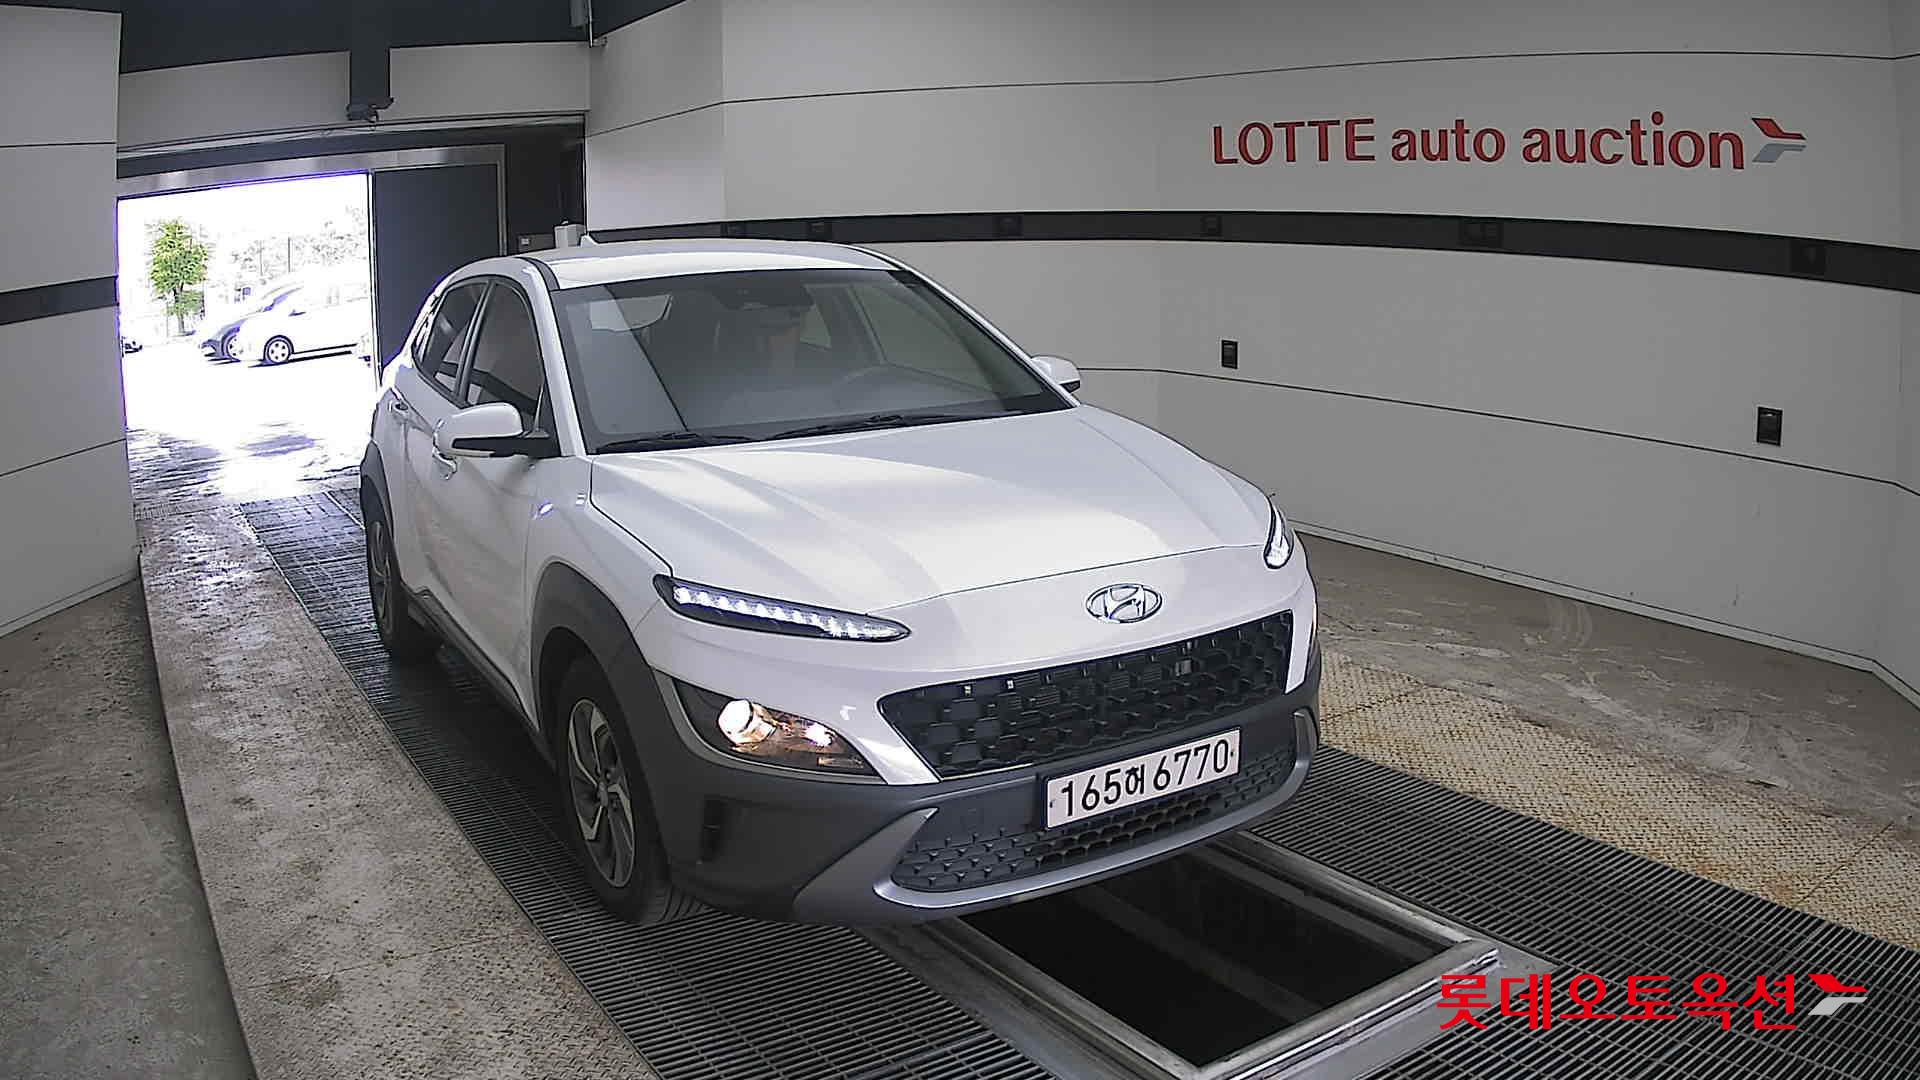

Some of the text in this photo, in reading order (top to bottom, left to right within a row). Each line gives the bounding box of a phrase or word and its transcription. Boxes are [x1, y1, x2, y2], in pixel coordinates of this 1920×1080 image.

[1212, 111, 1745, 170] LOTTE auto auction
[1061, 738, 1230, 817] 165허 6770
